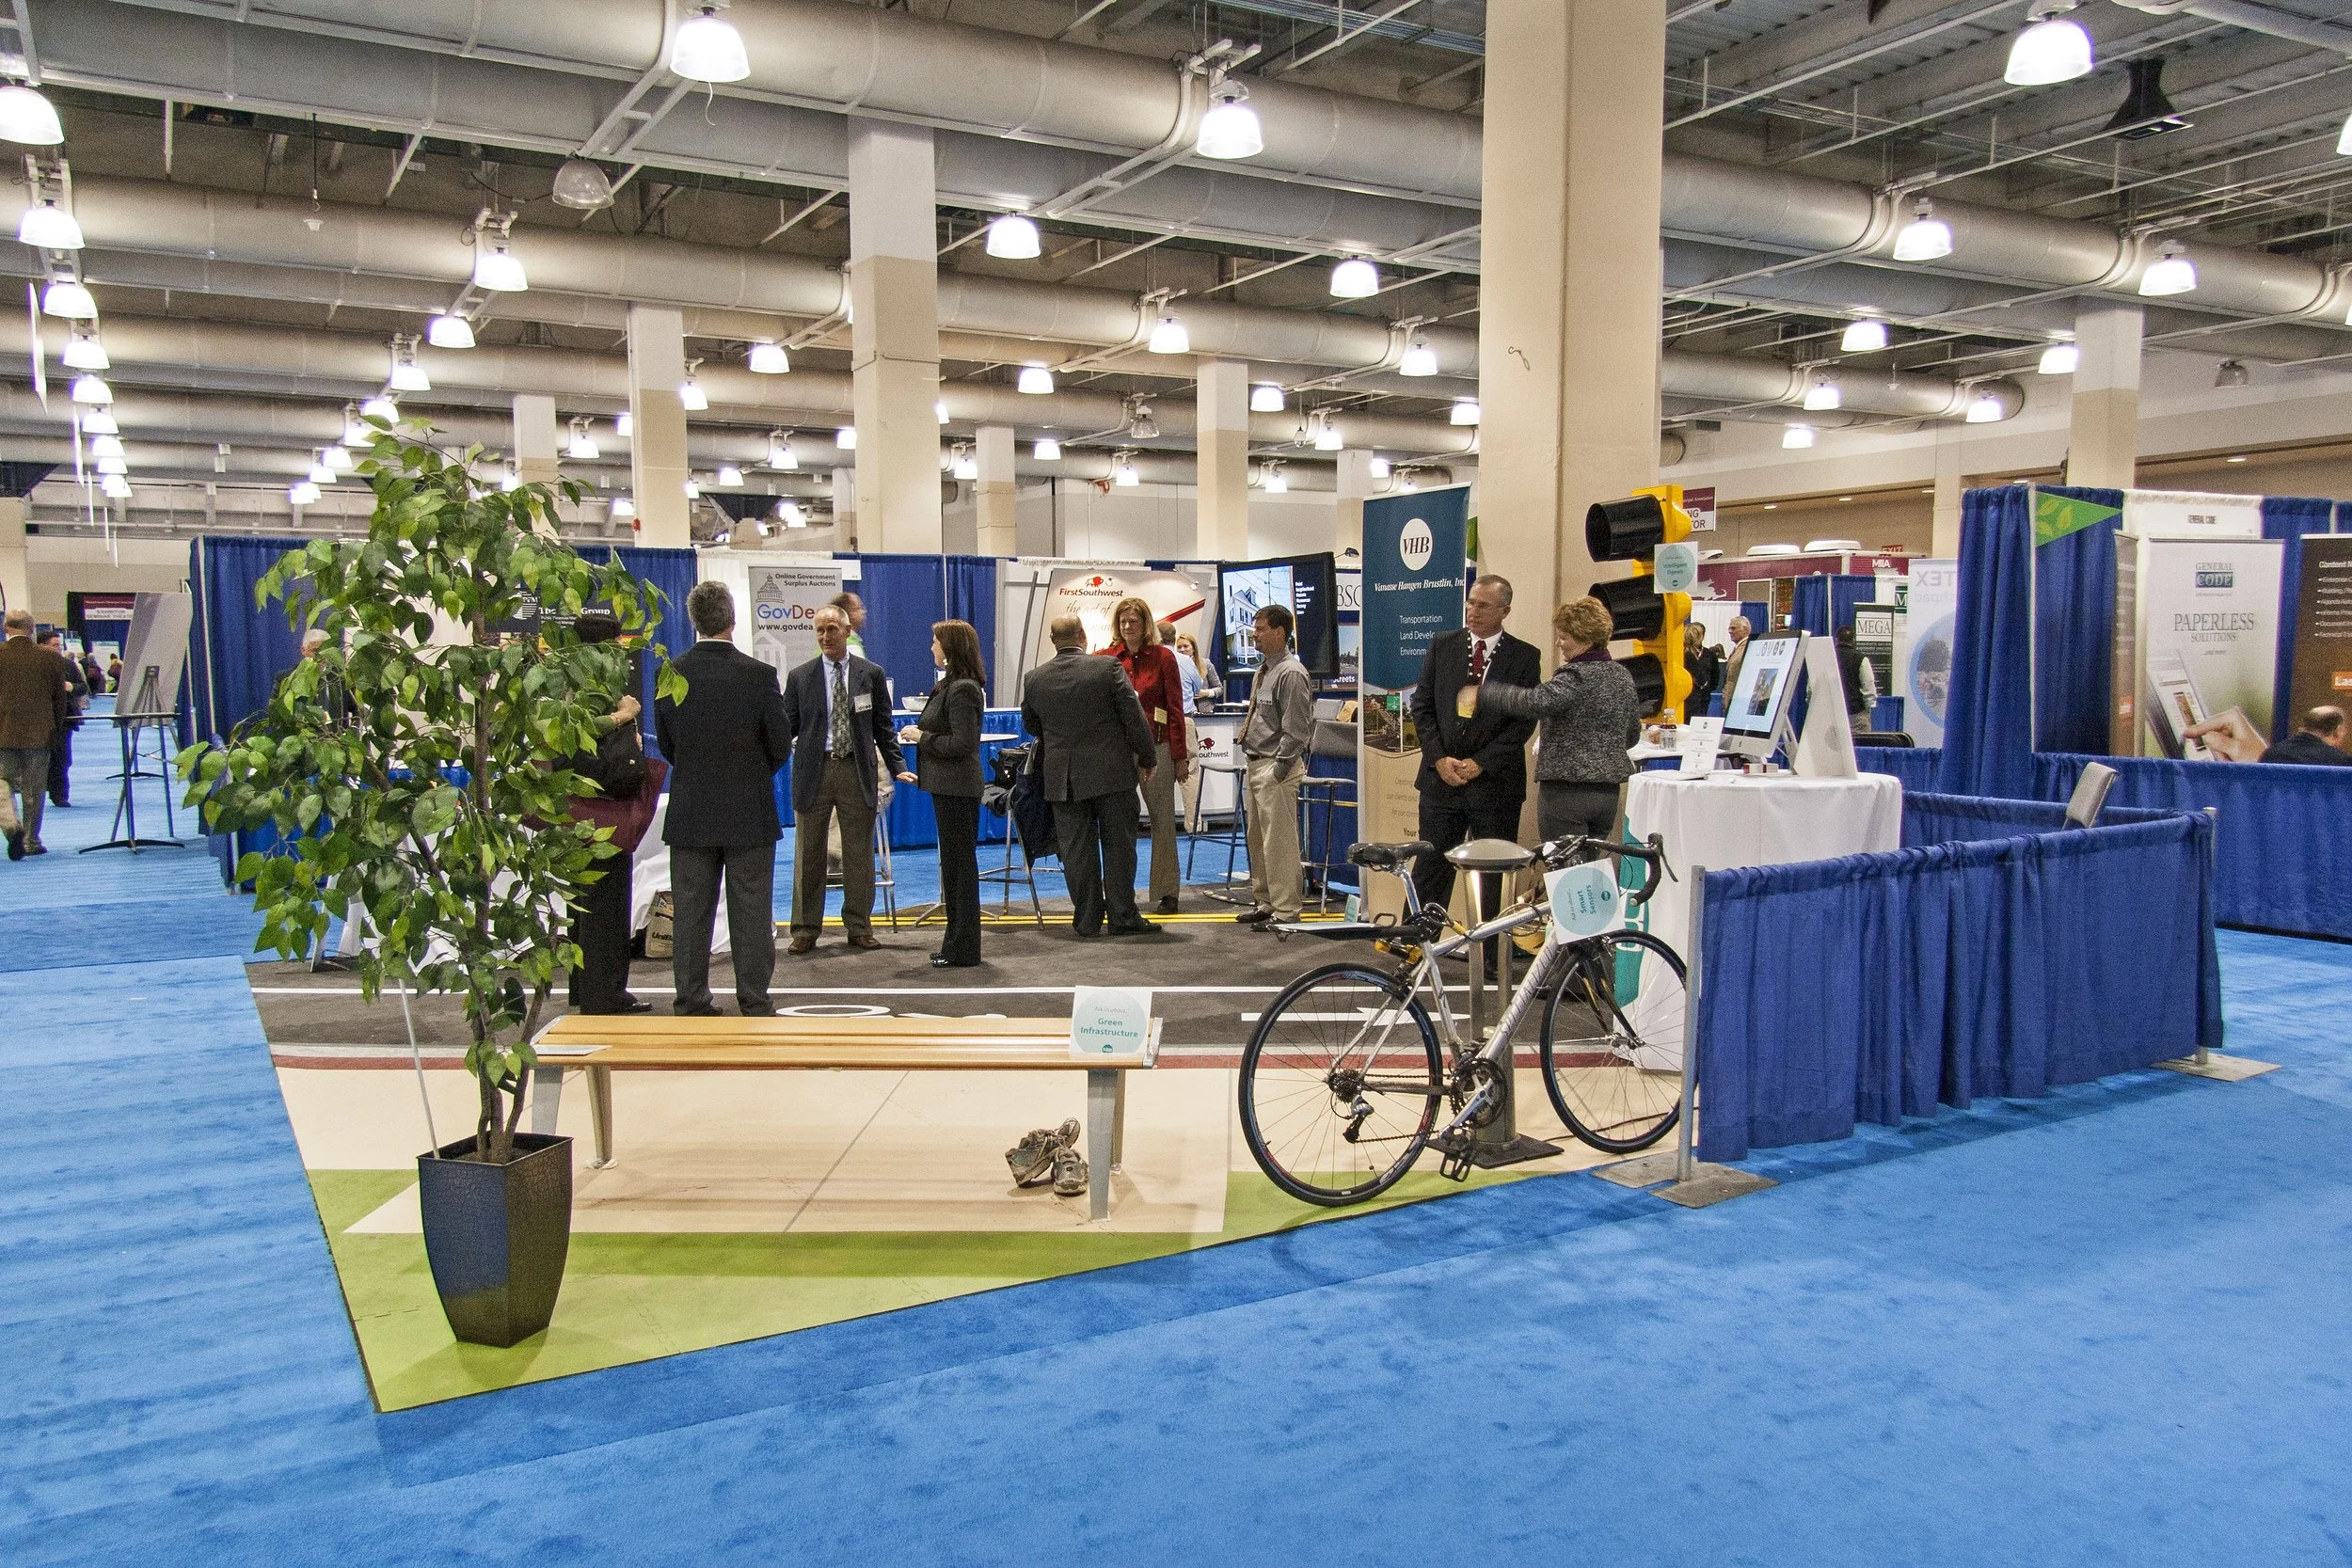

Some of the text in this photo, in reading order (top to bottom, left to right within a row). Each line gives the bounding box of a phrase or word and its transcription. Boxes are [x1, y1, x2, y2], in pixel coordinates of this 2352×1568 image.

[1403, 536, 1429, 555] VHB
[2195, 562, 2233, 571] GENERAL
[2197, 573, 2232, 587] CODE
[1058, 588, 1124, 597] FirstSouthwest
[1375, 582, 1398, 592] Vanasse
[1398, 580, 1422, 593] Hangen
[580, 607, 611, 617] Group
[1066, 600, 1081, 613] the
[1399, 614, 1443, 626] Transportation
[2173, 612, 2254, 632] PAPERLESS
[1857, 620, 1892, 635] MEGA
[1399, 631, 1413, 641] Land
[2190, 632, 2237, 643] SOLUTIONS
[1577, 890, 1587, 914] Smart
[1586, 884, 1597, 914] Sensors
[1097, 1017, 1123, 1026] Green
[1080, 1026, 1139, 1038] Infrastructure
